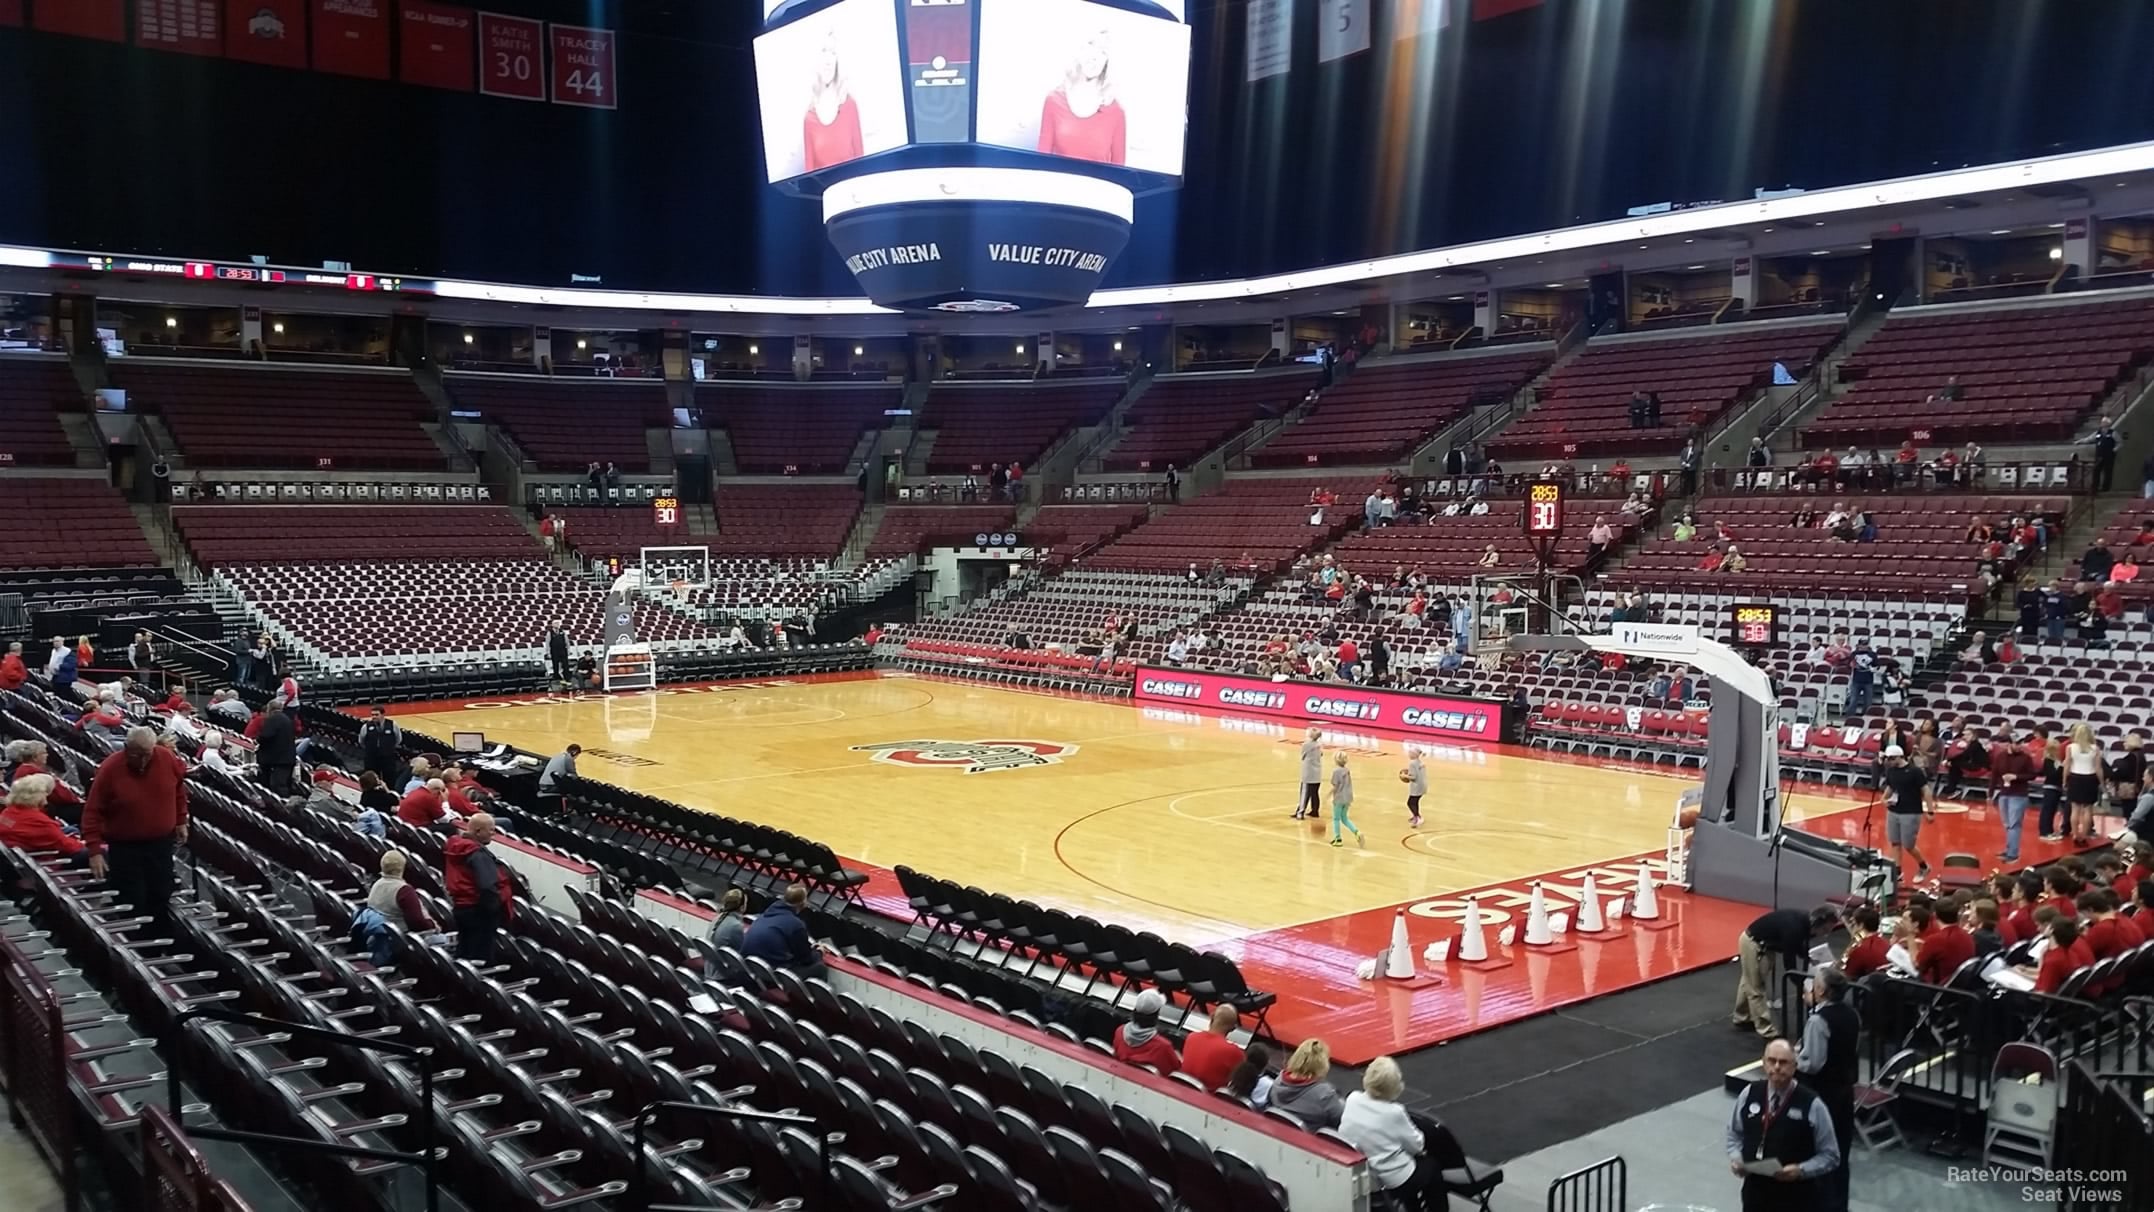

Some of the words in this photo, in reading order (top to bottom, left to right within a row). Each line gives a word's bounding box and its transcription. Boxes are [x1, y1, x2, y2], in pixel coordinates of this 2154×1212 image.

[1338, 4, 1351, 32] 5
[490, 24, 529, 40] KATIE
[491, 37, 531, 51] SMITH
[559, 36, 608, 51] TRACEY
[495, 52, 531, 80] 30
[567, 54, 599, 66] HALL
[565, 70, 604, 96] 44
[862, 248, 888, 270] CITY
[889, 243, 941, 265] ARENA
[988, 243, 1043, 264] VALUE
[1043, 247, 1081, 268] CITY
[1074, 252, 1108, 273] ARENA
[1913, 430, 1930, 440] 106
[1531, 485, 1558, 501] 28:53
[657, 508, 676, 524] 30
[1534, 502, 1555, 530] 30
[1737, 608, 1772, 623] 28:53
[1640, 632, 1683, 641] Nationwide
[1142, 679, 1186, 697] CASE
[1219, 687, 1268, 707] CASE
[1305, 697, 1358, 718] CASE
[1402, 706, 1465, 731] CASE
